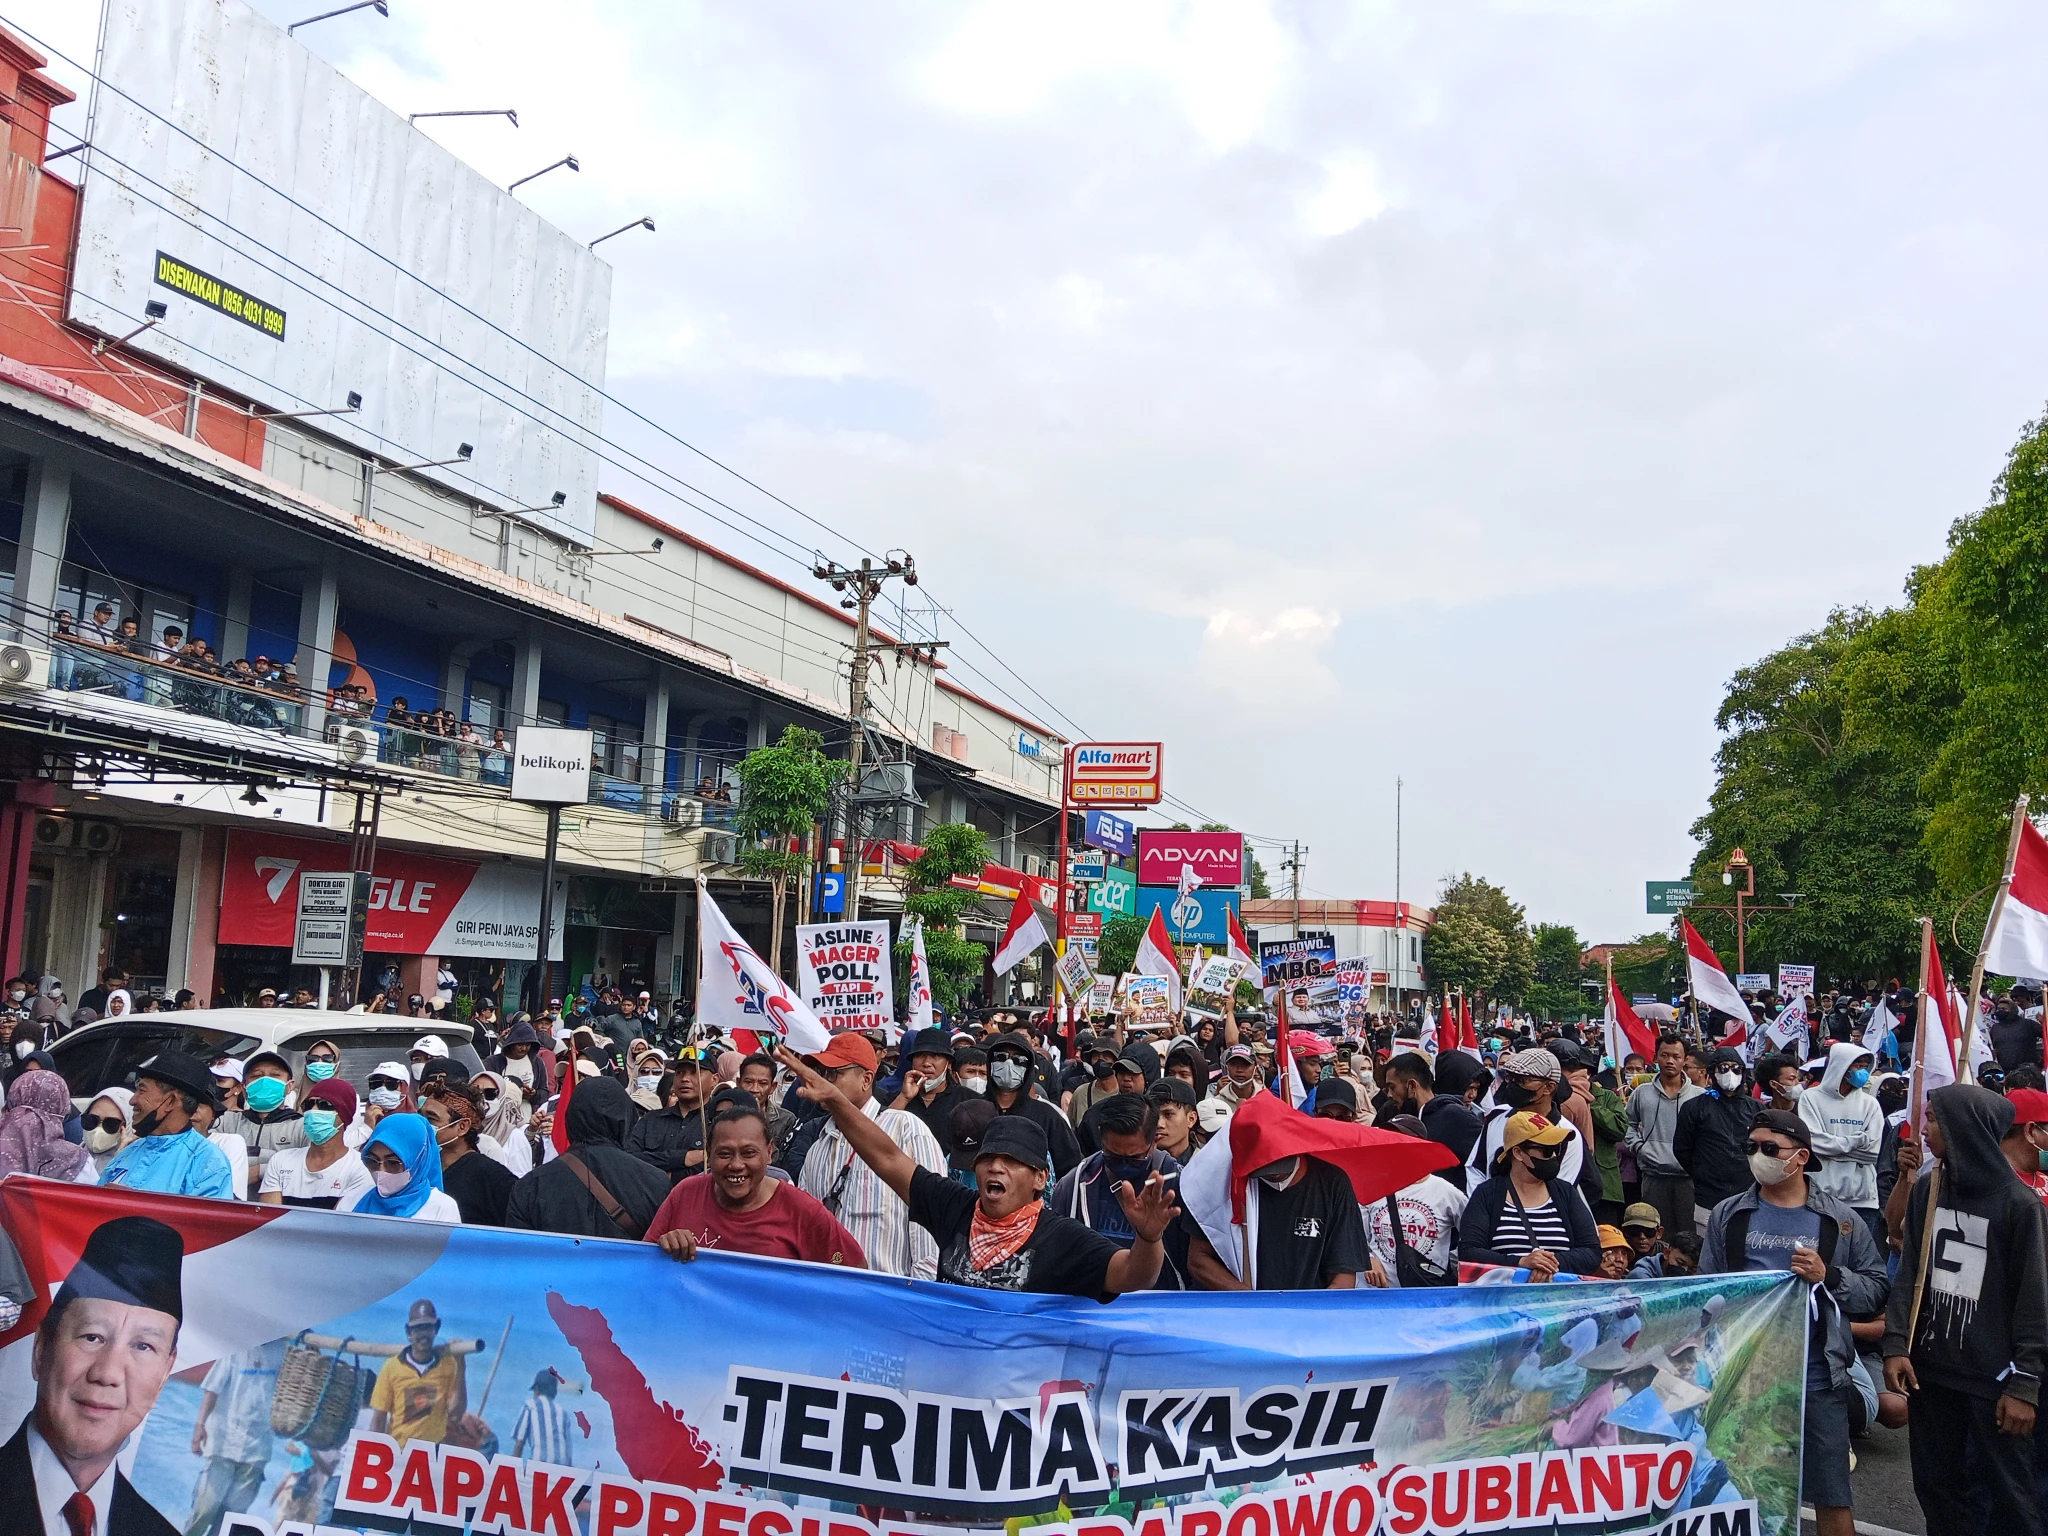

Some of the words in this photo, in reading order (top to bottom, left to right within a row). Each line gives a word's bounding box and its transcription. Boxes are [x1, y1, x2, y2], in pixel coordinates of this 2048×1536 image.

[159, 257, 220, 305] DISEWAKAN
[222, 288, 242, 316] 0856
[243, 299, 263, 325] 4031
[263, 309, 283, 335] 9999
[521, 755, 585, 773] belikopi.
[1078, 750, 1152, 764] Alfamart
[1085, 856, 1101, 864] BNI
[1144, 848, 1238, 862] ADVAN
[308, 880, 331, 888] DOKTER
[820, 878, 839, 907] P
[367, 877, 436, 914] GLE
[1094, 880, 1130, 910] acer
[456, 921, 476, 934] GIRI
[478, 922, 502, 936] PENI
[503, 925, 524, 937] JAYA
[525, 926, 555, 939] SPT
[815, 929, 873, 948] ASLINE
[1183, 932, 1215, 940] COMPUTER
[809, 946, 880, 969] MAGER
[816, 963, 880, 983] POLL,
[833, 983, 861, 993] TAPI
[812, 994, 844, 1008] PIYE
[846, 991, 884, 1006] NEH?
[834, 1007, 860, 1015] DEMI
[1529, 1113, 1549, 1130] N
[733, 1376, 1104, 1492] TERIMA
[1119, 1384, 1386, 1472] KASIH
[346, 1440, 582, 1536] BAPAK
[1390, 1449, 1693, 1534] SUBIANTO
